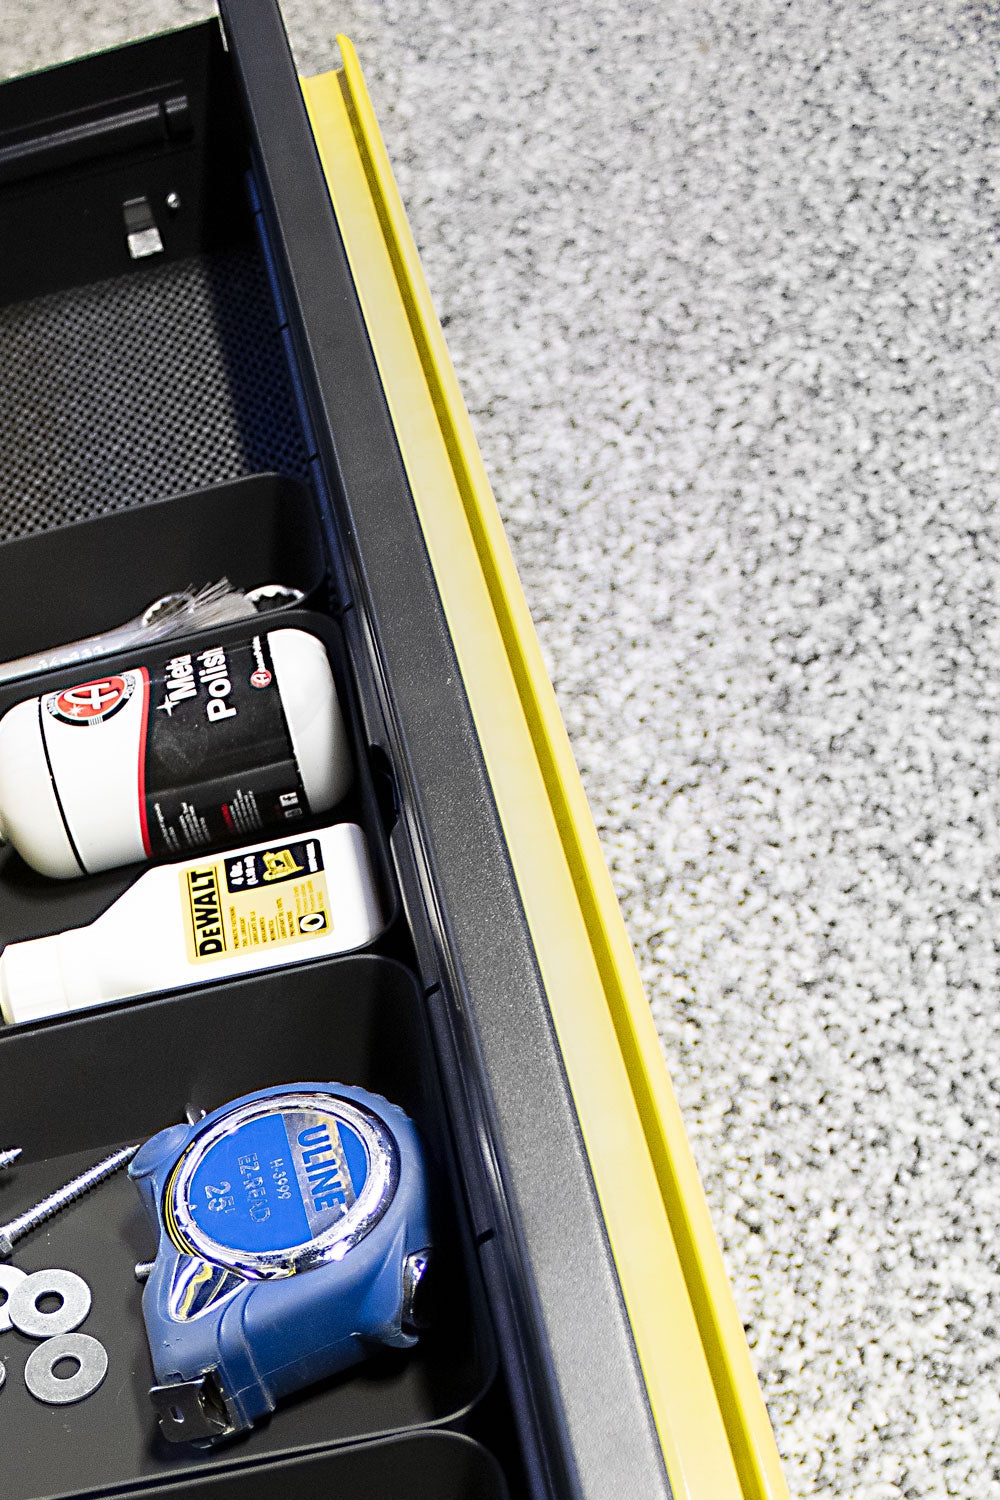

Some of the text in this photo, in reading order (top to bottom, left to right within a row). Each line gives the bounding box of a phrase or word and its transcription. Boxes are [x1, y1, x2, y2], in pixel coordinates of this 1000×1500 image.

[197, 647, 237, 721] Polish
[237, 1152, 271, 1223] EZ-READ
[270, 1158, 292, 1200] H-3999
[297, 1123, 346, 1212] ULINE
